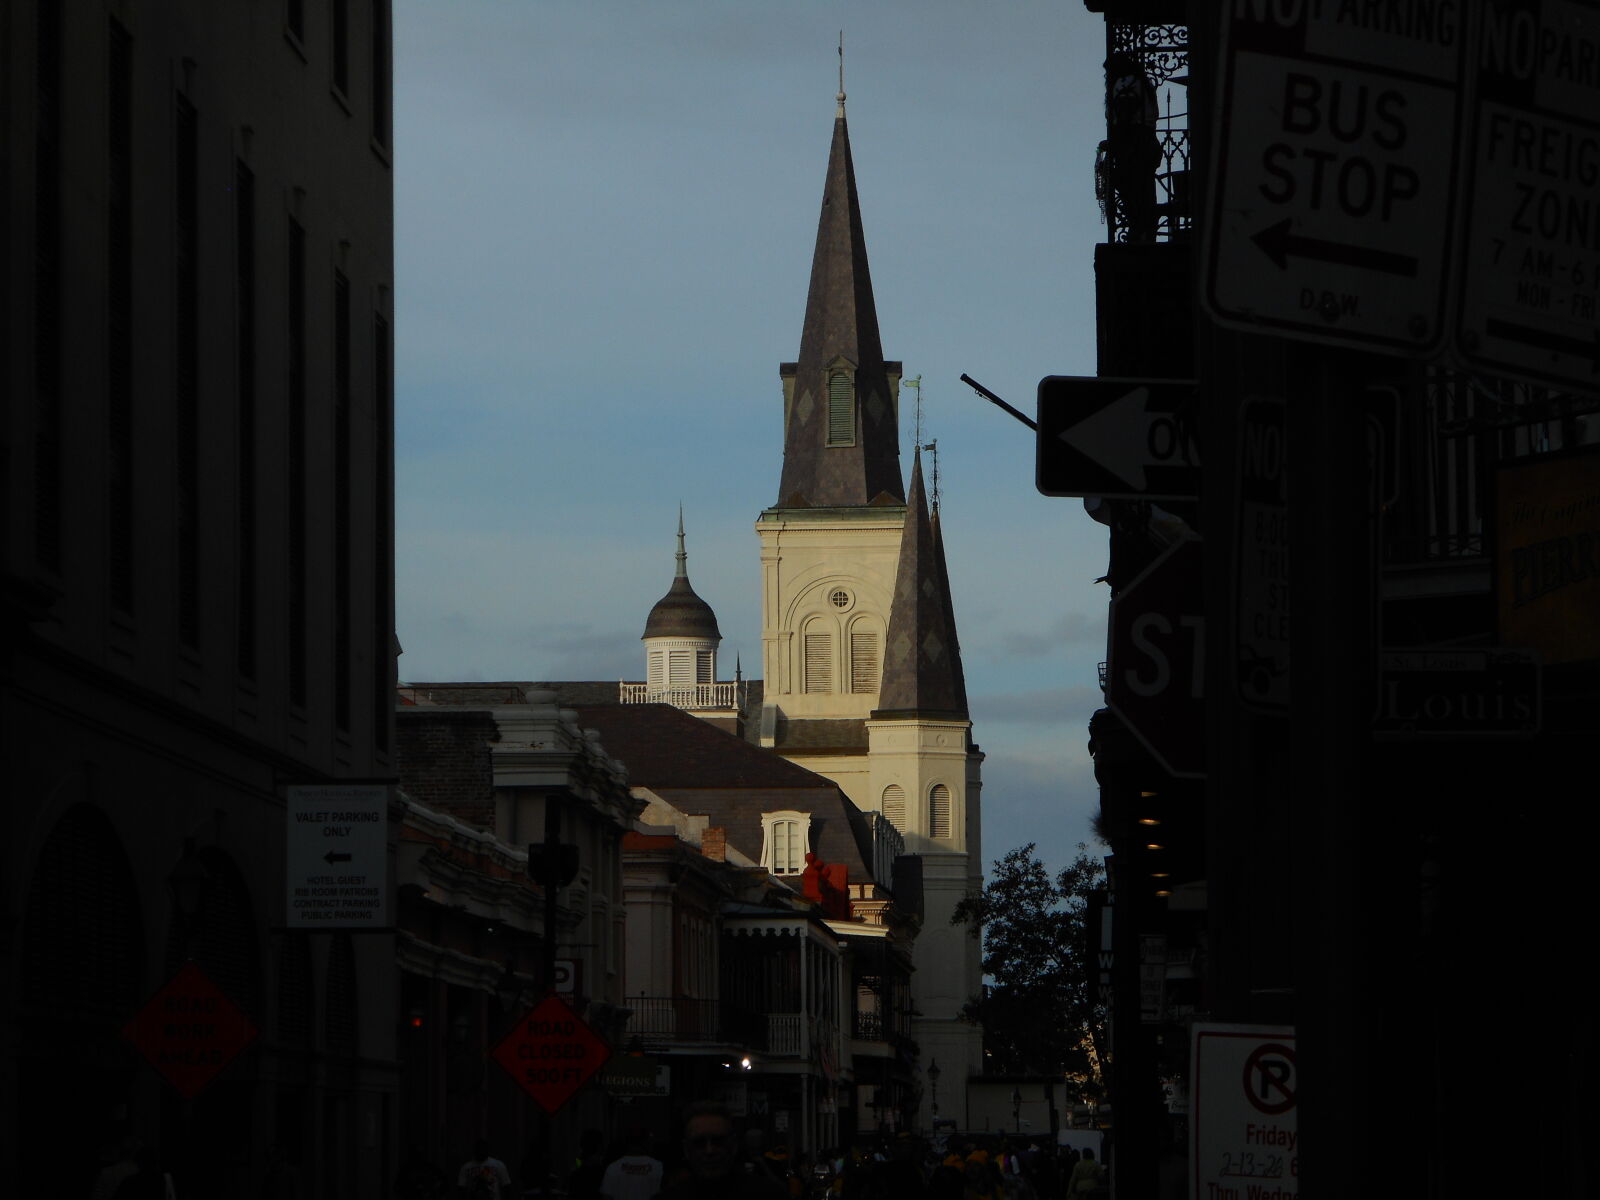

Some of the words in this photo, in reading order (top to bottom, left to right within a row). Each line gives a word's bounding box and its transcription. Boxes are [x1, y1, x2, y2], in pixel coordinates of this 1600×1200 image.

[1482, 0, 1536, 80] NO
[1541, 27, 1600, 89] PAR
[1282, 73, 1407, 150] BUS
[1259, 143, 1420, 222] STOP
[1511, 181, 1600, 251] ZON
[1492, 238, 1505, 265] 7
[1516, 279, 1552, 310] MON
[1244, 422, 1282, 481] NO
[1382, 679, 1531, 720] Louis
[295, 812, 330, 823] VALET
[332, 812, 379, 823] PARKING
[323, 826, 351, 837] ONLY
[306, 876, 335, 885] HOTEL
[337, 876, 367, 885] GUEST
[294, 899, 339, 908] CONTRACT
[342, 899, 380, 908] PARKING
[311, 888, 336, 897] ROOM
[339, 888, 379, 897] PATRONS
[301, 911, 333, 920] PUBLIC
[335, 911, 372, 920] PARKING
[528, 1020, 575, 1037] ROAD
[519, 1044, 585, 1059] CLOSED
[1247, 1124, 1298, 1152] Friday
[1208, 1183, 1239, 1200] Thru
